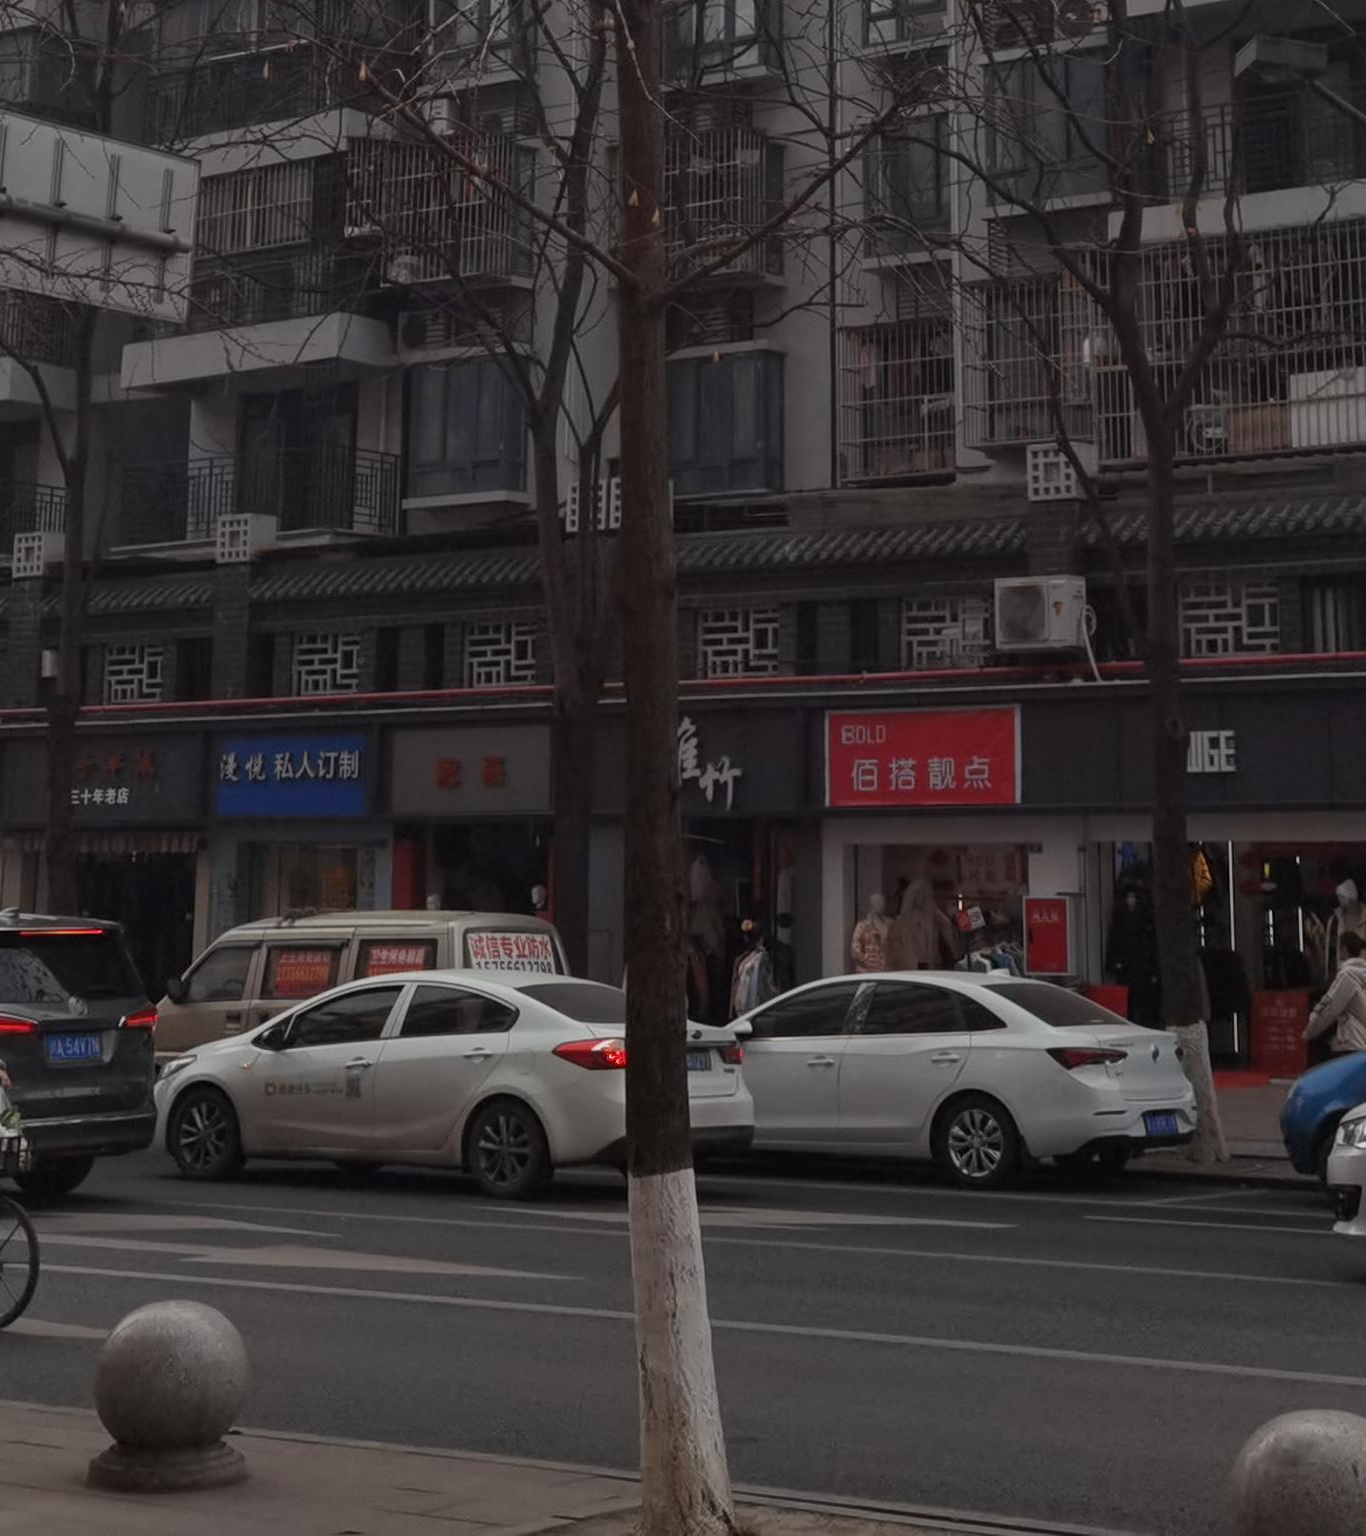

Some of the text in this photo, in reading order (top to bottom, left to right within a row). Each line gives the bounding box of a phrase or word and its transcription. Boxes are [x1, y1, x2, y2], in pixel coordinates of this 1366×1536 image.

[274, 749, 360, 781] 私人订制
[851, 755, 991, 792] 佰搭靓点
[71, 787, 130, 806] 三十年老店
[469, 935, 553, 960] 诚信专业防水
